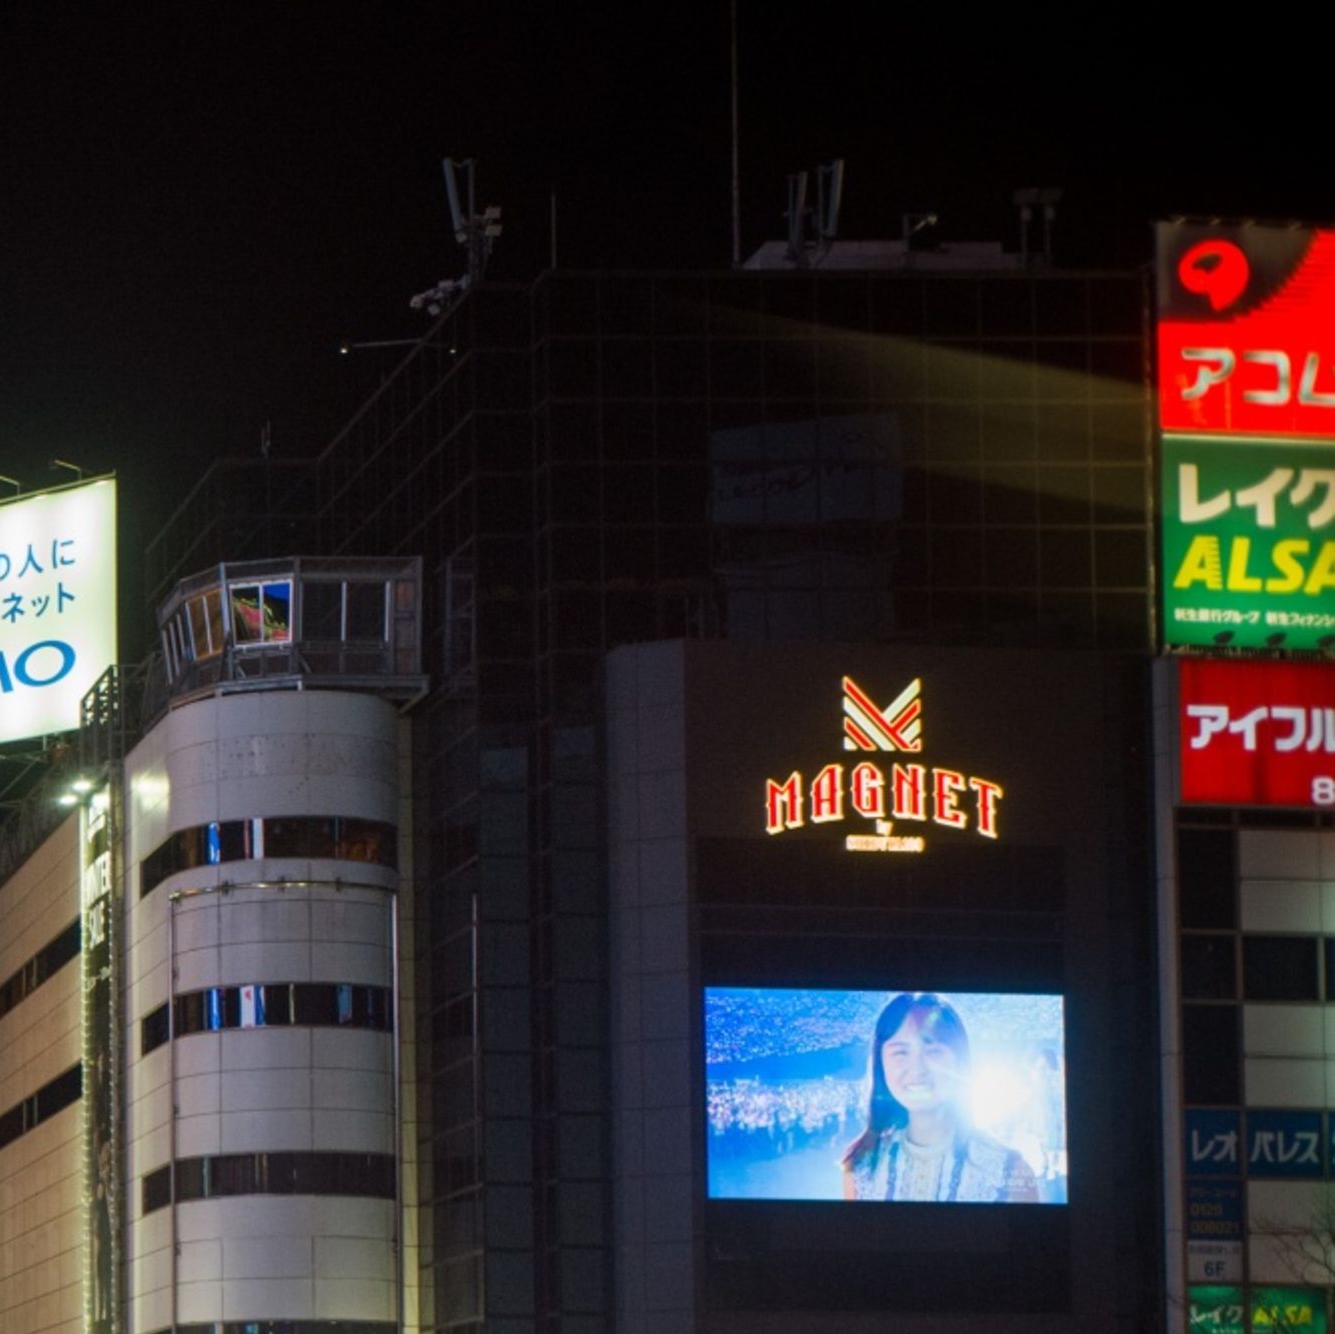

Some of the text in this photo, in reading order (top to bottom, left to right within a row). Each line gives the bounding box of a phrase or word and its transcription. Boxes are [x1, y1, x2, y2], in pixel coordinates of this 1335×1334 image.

[1179, 463, 1335, 529] レイク
[1187, 704, 1335, 753] アイフル
[765, 762, 1004, 839] MAGNET
[1191, 1129, 1335, 1164] レオパレス
